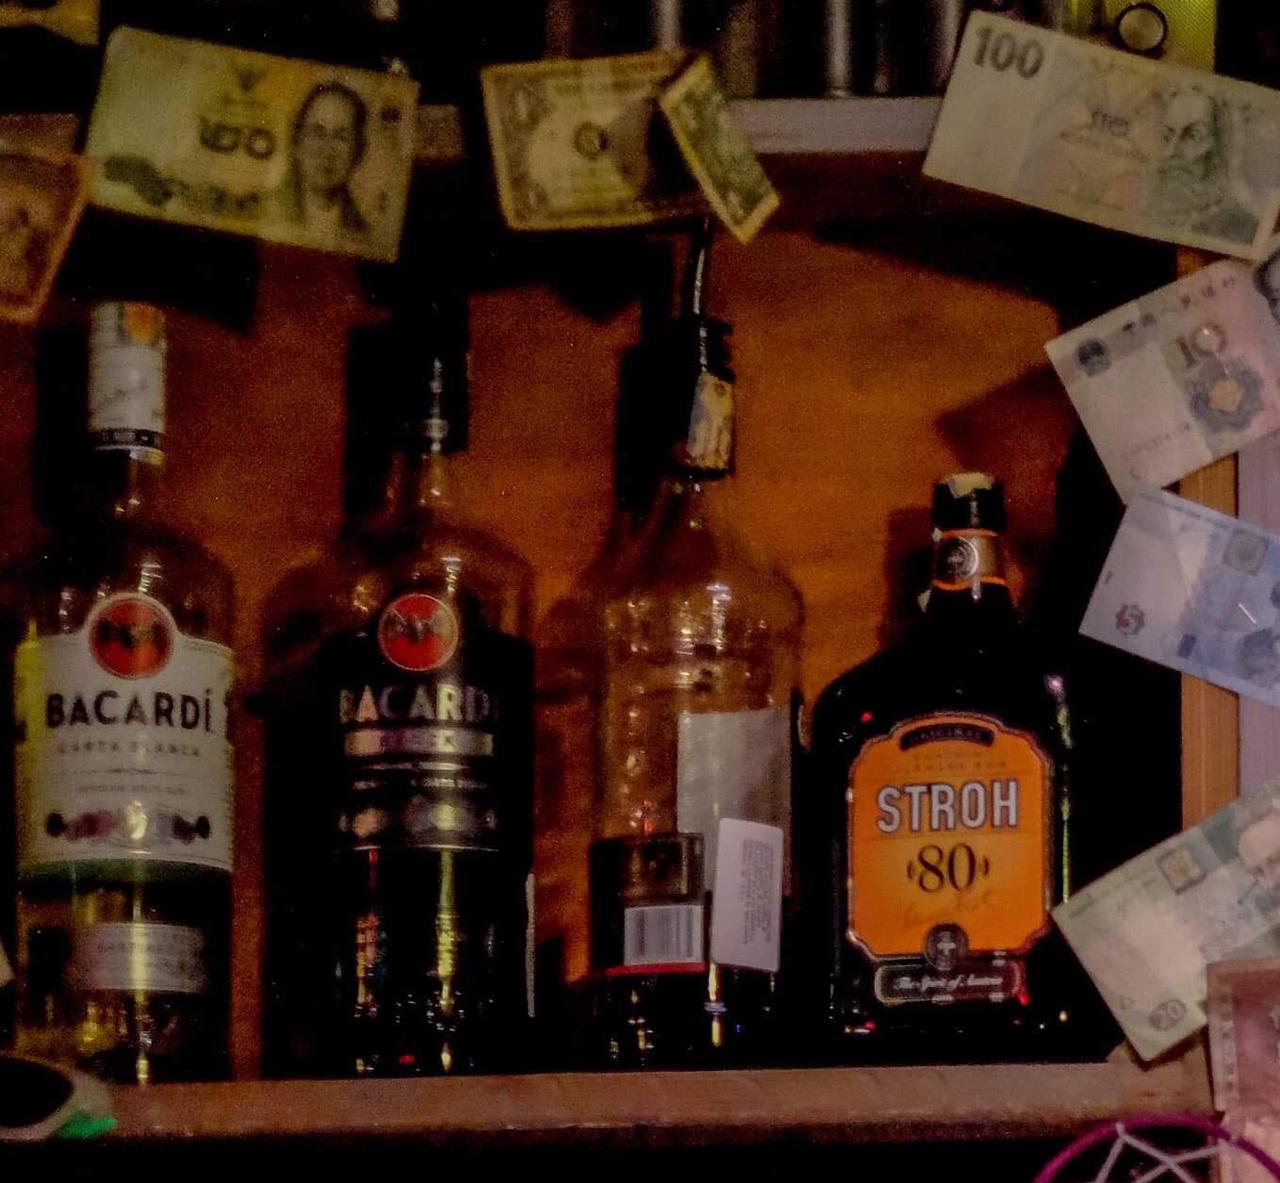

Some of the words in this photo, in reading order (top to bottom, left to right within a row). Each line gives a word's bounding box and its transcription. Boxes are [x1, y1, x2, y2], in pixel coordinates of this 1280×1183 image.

[972, 26, 1044, 79] 100
[338, 682, 500, 725] BACARD
[877, 780, 1019, 834] STROH
[917, 842, 978, 894] 80
